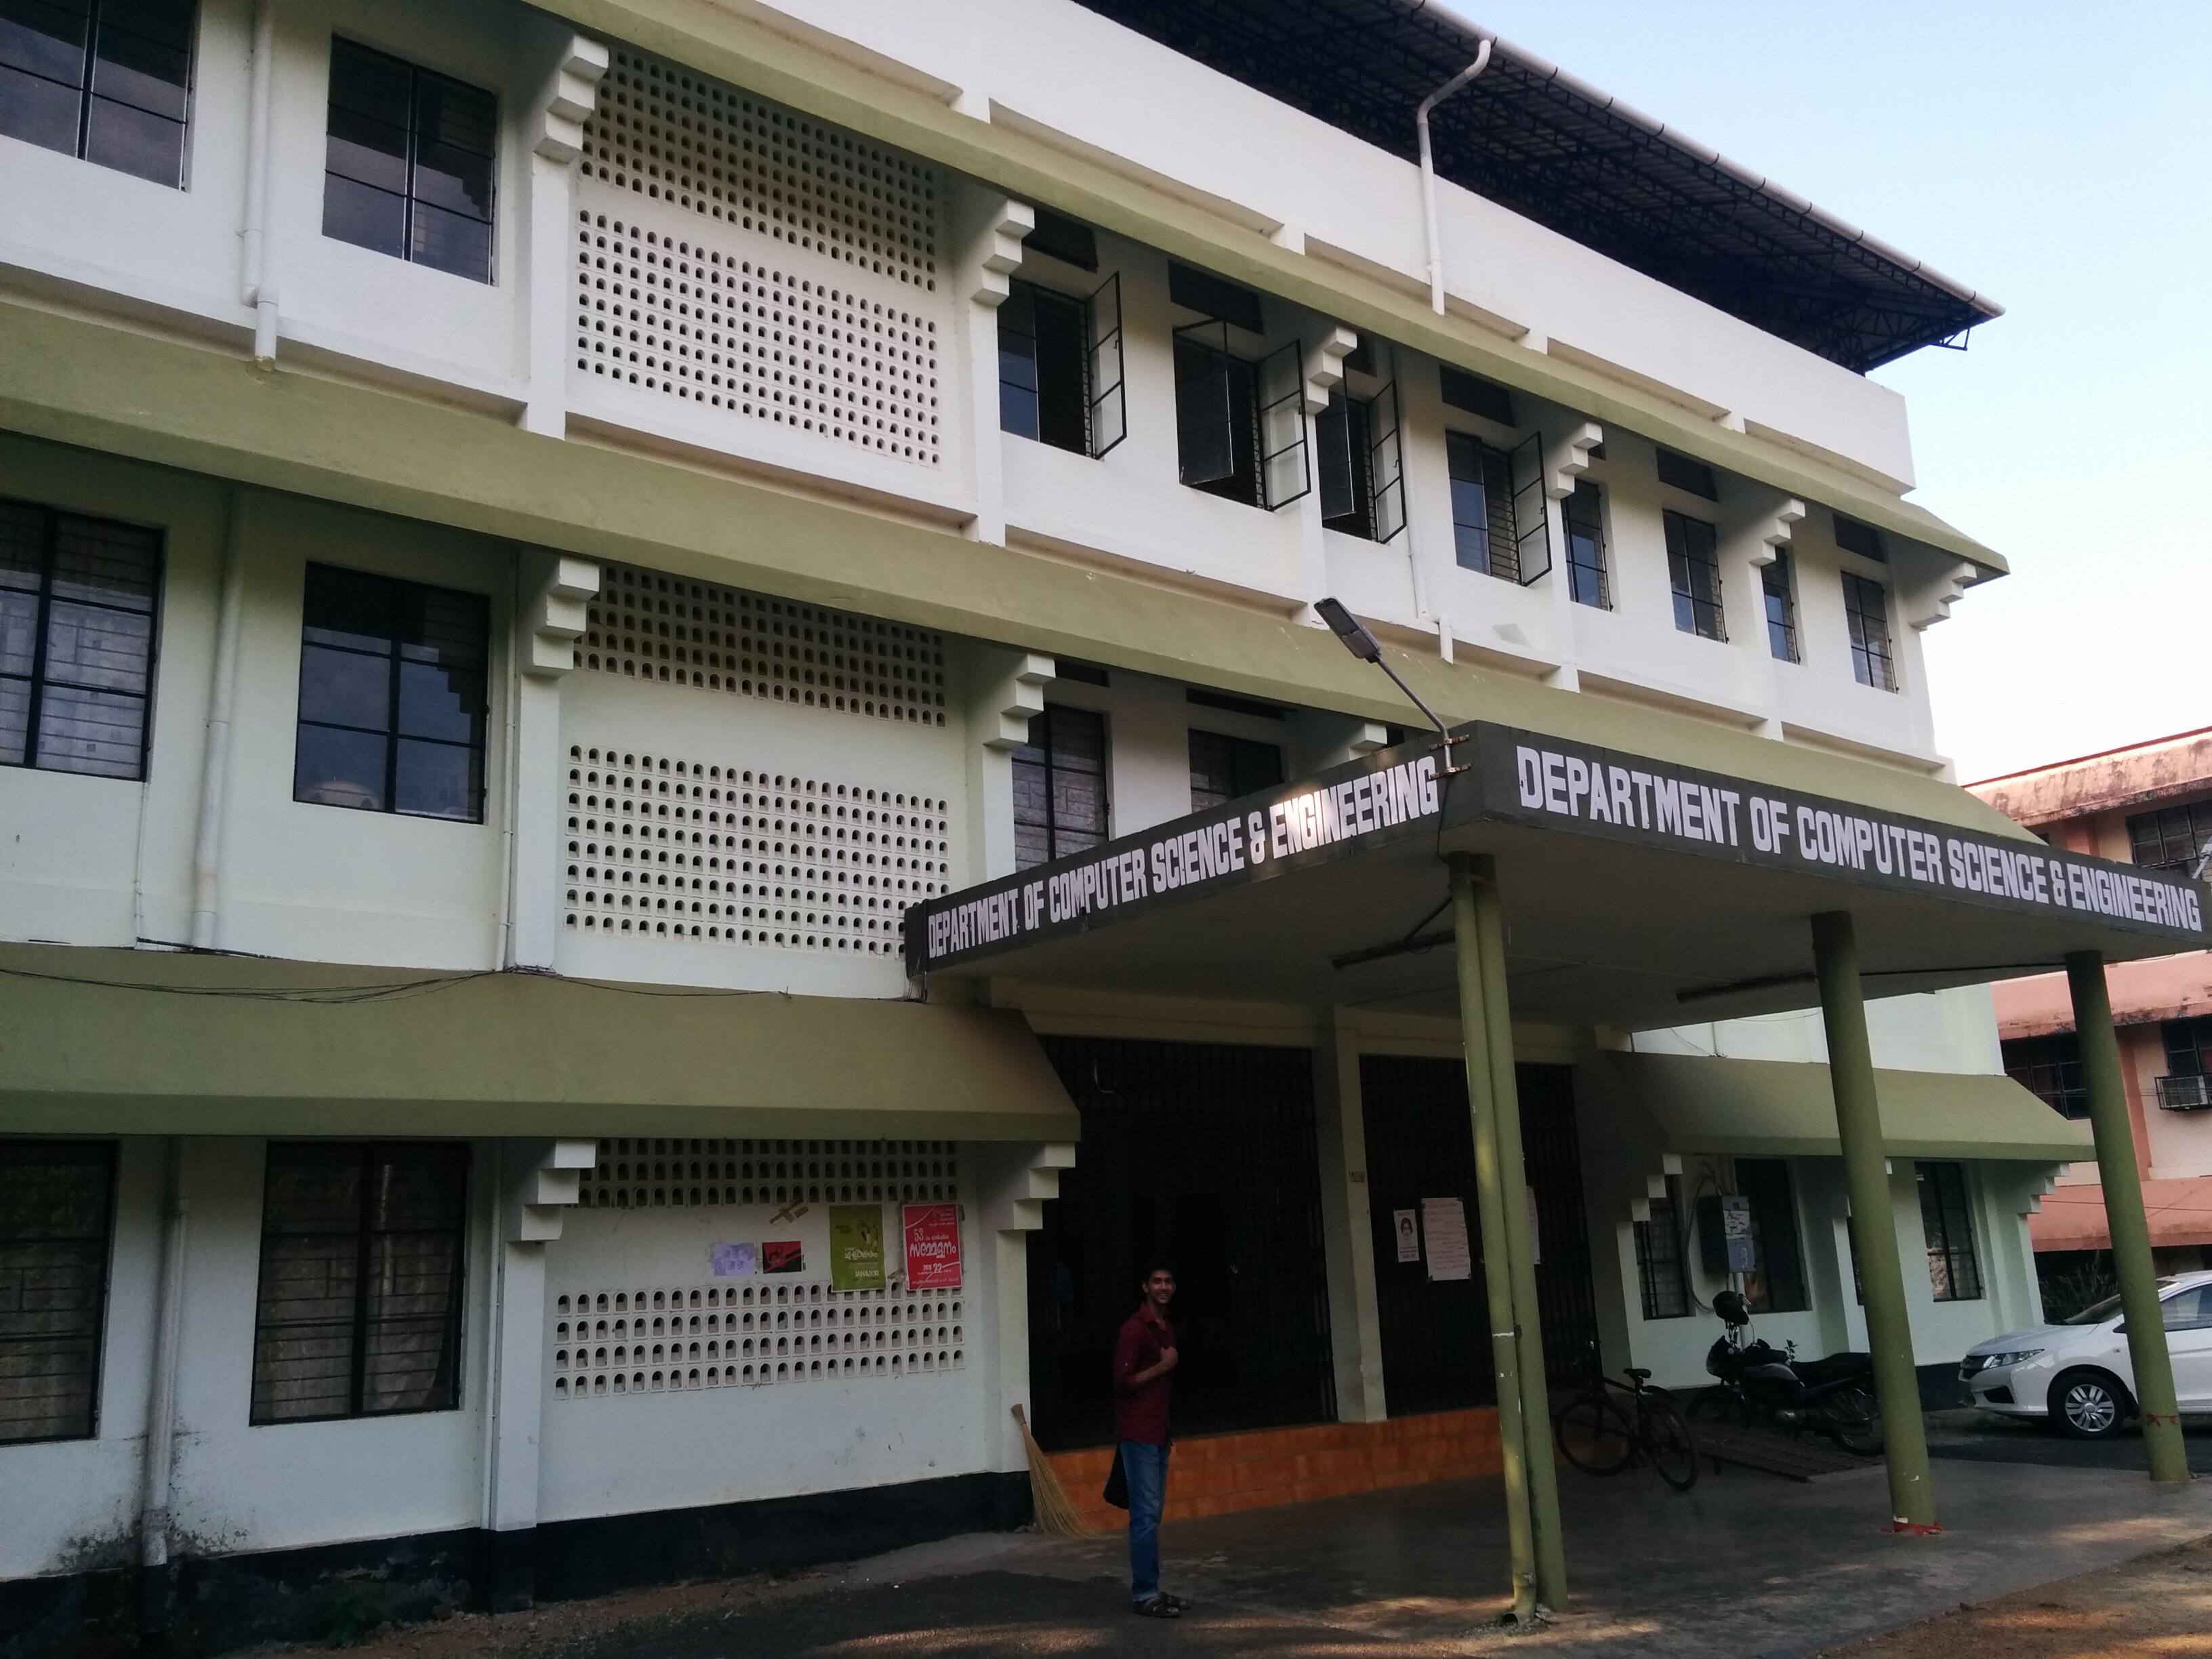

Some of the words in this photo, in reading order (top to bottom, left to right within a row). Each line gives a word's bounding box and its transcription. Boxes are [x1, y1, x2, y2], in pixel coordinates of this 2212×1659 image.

[928, 888, 1019, 958] DEPARTMENT
[1024, 883, 1044, 930] OF
[1049, 848, 1147, 924] COMPUTER
[1151, 817, 1244, 894] SCIENCE
[1248, 811, 1266, 865] &
[1269, 756, 1439, 859] ENGINEERING
[1516, 745, 1740, 846] DEPARTMENT
[1750, 796, 1790, 854] OF
[1797, 806, 1944, 884] COMPUTER
[1947, 839, 2049, 904] SCIENCE
[2051, 862, 2068, 905] &
[2070, 866, 2201, 932] ENGINEERING
[914, 1227, 924, 1242] 53
